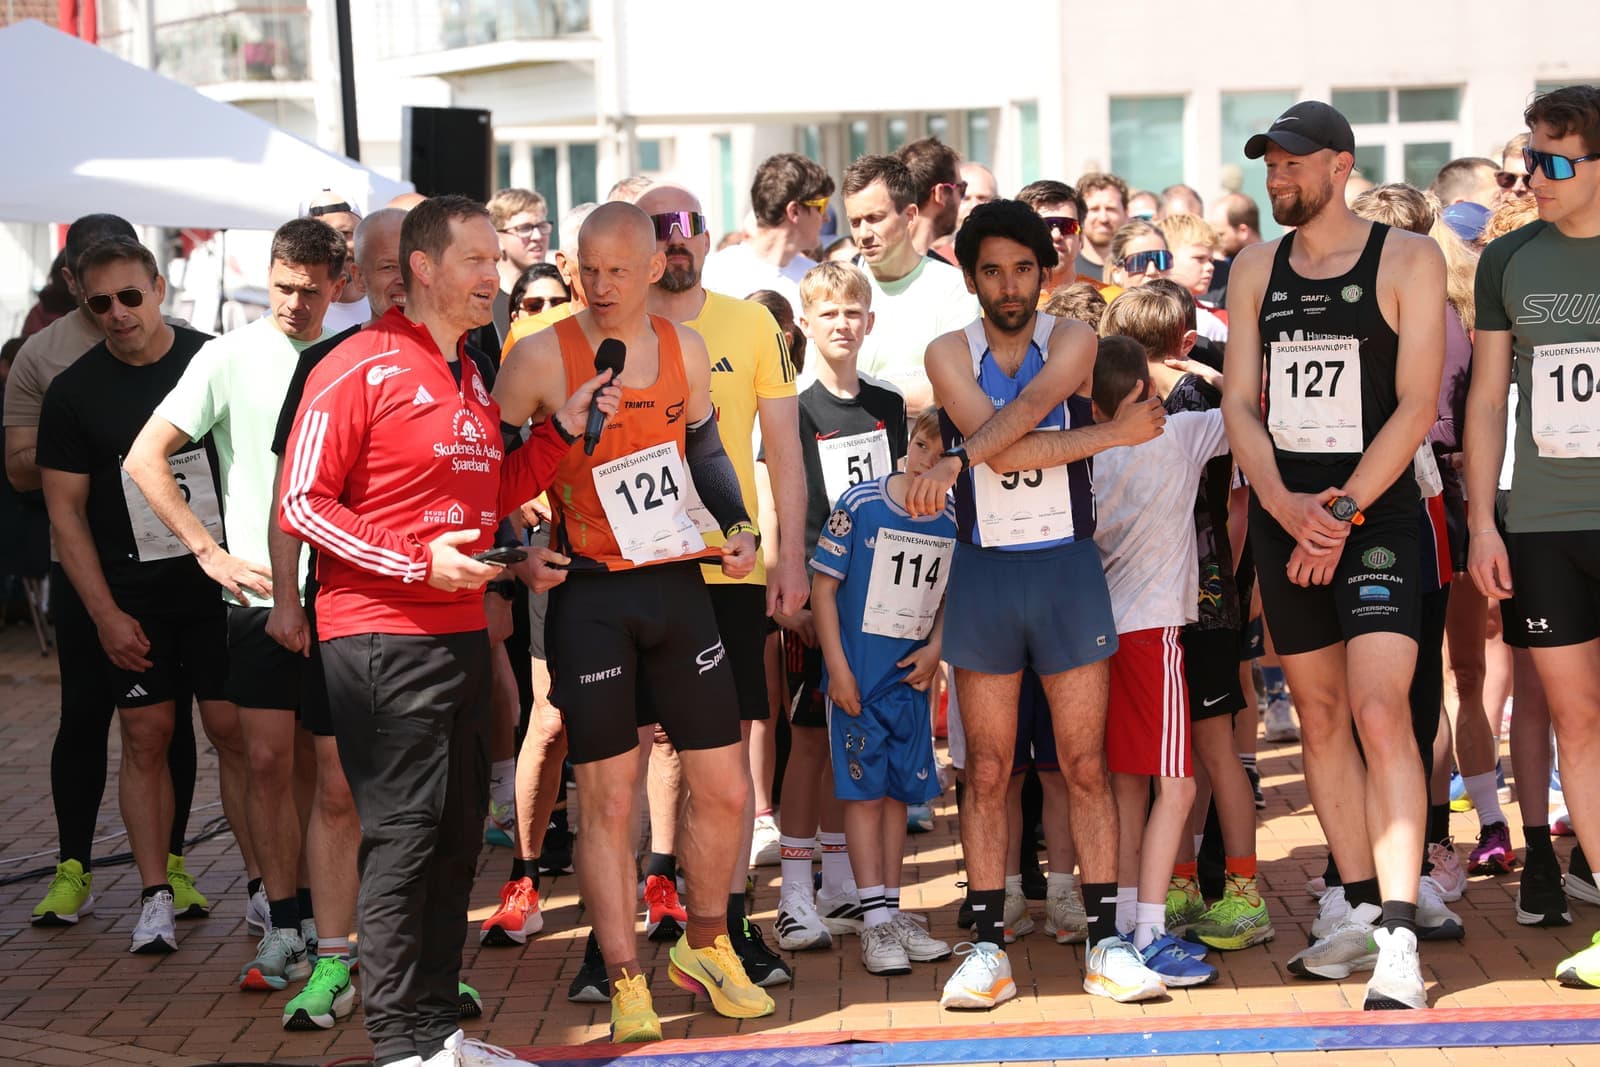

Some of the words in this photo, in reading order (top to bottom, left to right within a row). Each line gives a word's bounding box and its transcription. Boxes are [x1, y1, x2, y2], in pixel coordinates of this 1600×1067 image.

[1300, 294, 1325, 303] CRAFT
[1516, 293, 1600, 325] SWI
[1277, 343, 1352, 353] SKUDENESHAVNLØPET
[1285, 360, 1345, 398] 127
[624, 400, 655, 409] TRIMTEX
[433, 441, 475, 458] Skudenes
[475, 443, 482, 456] &
[451, 457, 490, 474] Sparebank
[598, 447, 673, 478] SKUDENESHAVNLØPET
[847, 452, 875, 487] 51
[615, 465, 679, 515] 124
[891, 551, 942, 590] 114
[1347, 573, 1403, 584] DEEPOCEAN
[579, 666, 622, 684] TRIMTEX
